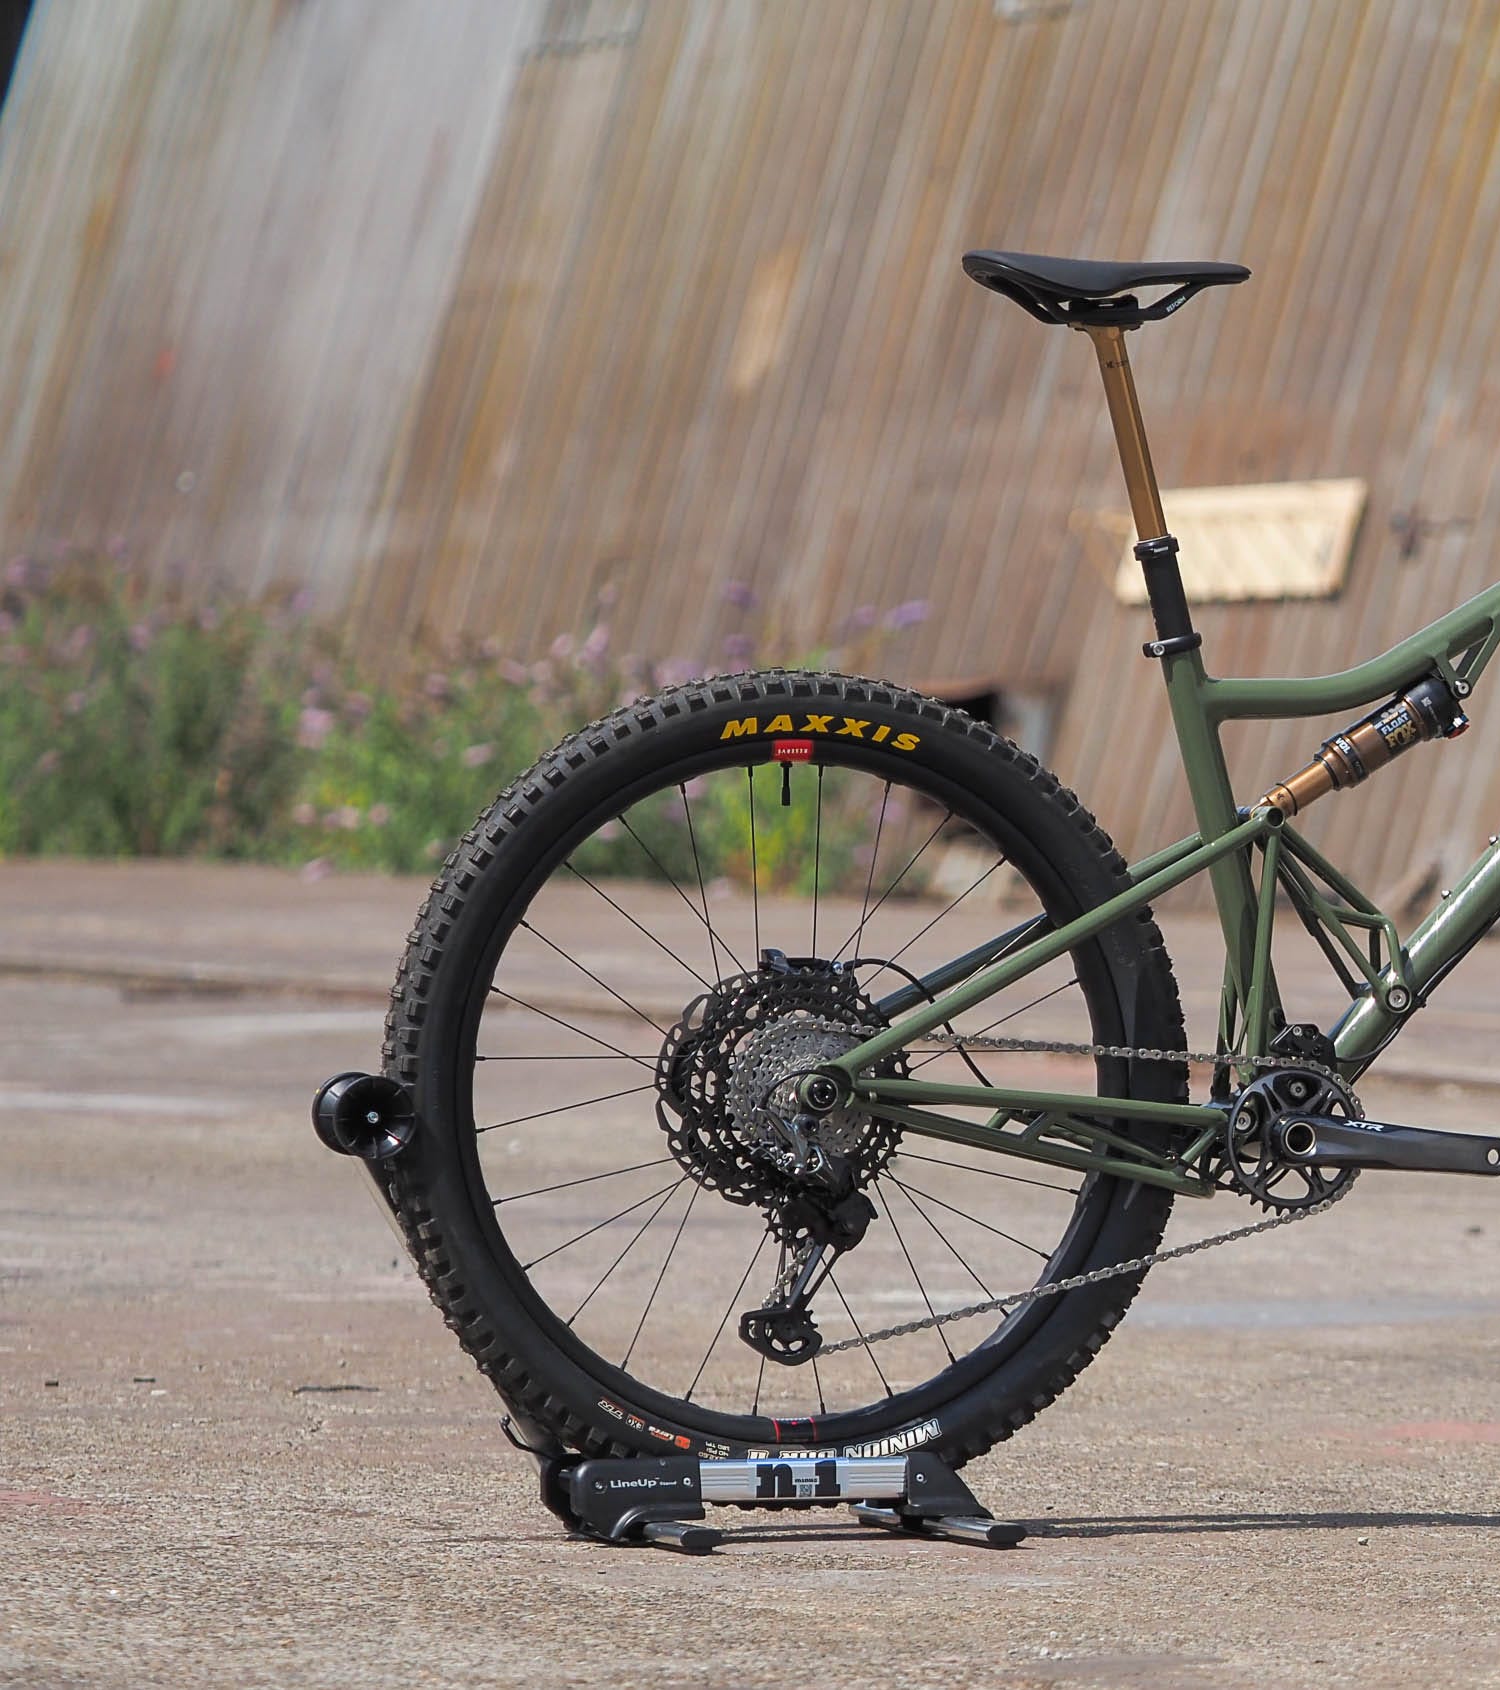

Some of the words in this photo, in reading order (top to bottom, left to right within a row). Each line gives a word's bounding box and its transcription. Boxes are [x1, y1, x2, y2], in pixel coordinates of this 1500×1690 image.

[720, 714, 921, 751] MAXXIS
[1381, 712, 1410, 735] FLOAT
[1385, 720, 1416, 748] FOX
[1343, 1119, 1385, 1132] XTR
[843, 1418, 942, 1459] MINION
